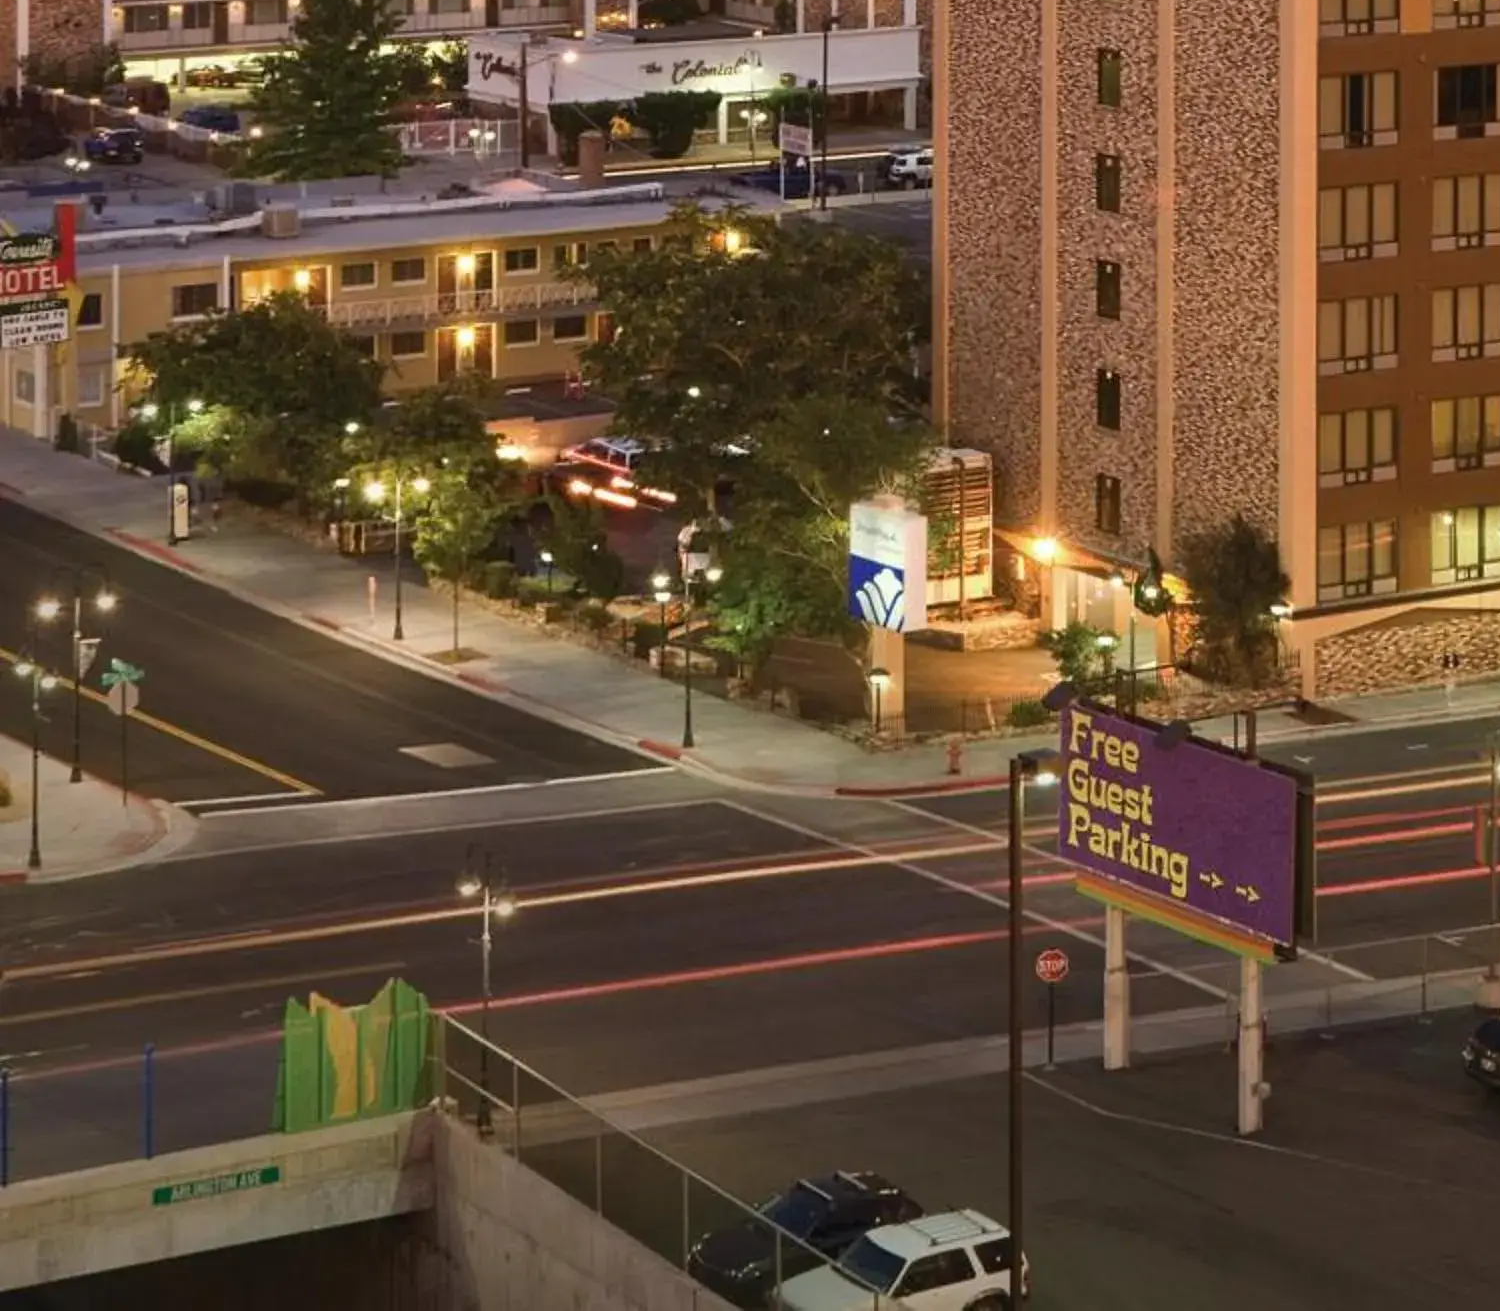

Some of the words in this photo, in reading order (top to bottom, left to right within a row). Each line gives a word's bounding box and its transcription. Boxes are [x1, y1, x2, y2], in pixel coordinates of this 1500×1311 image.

[0, 265, 64, 295] OTEL
[1069, 709, 1140, 774] Free
[1067, 758, 1154, 826] Guest
[1067, 802, 1189, 899] Parking
